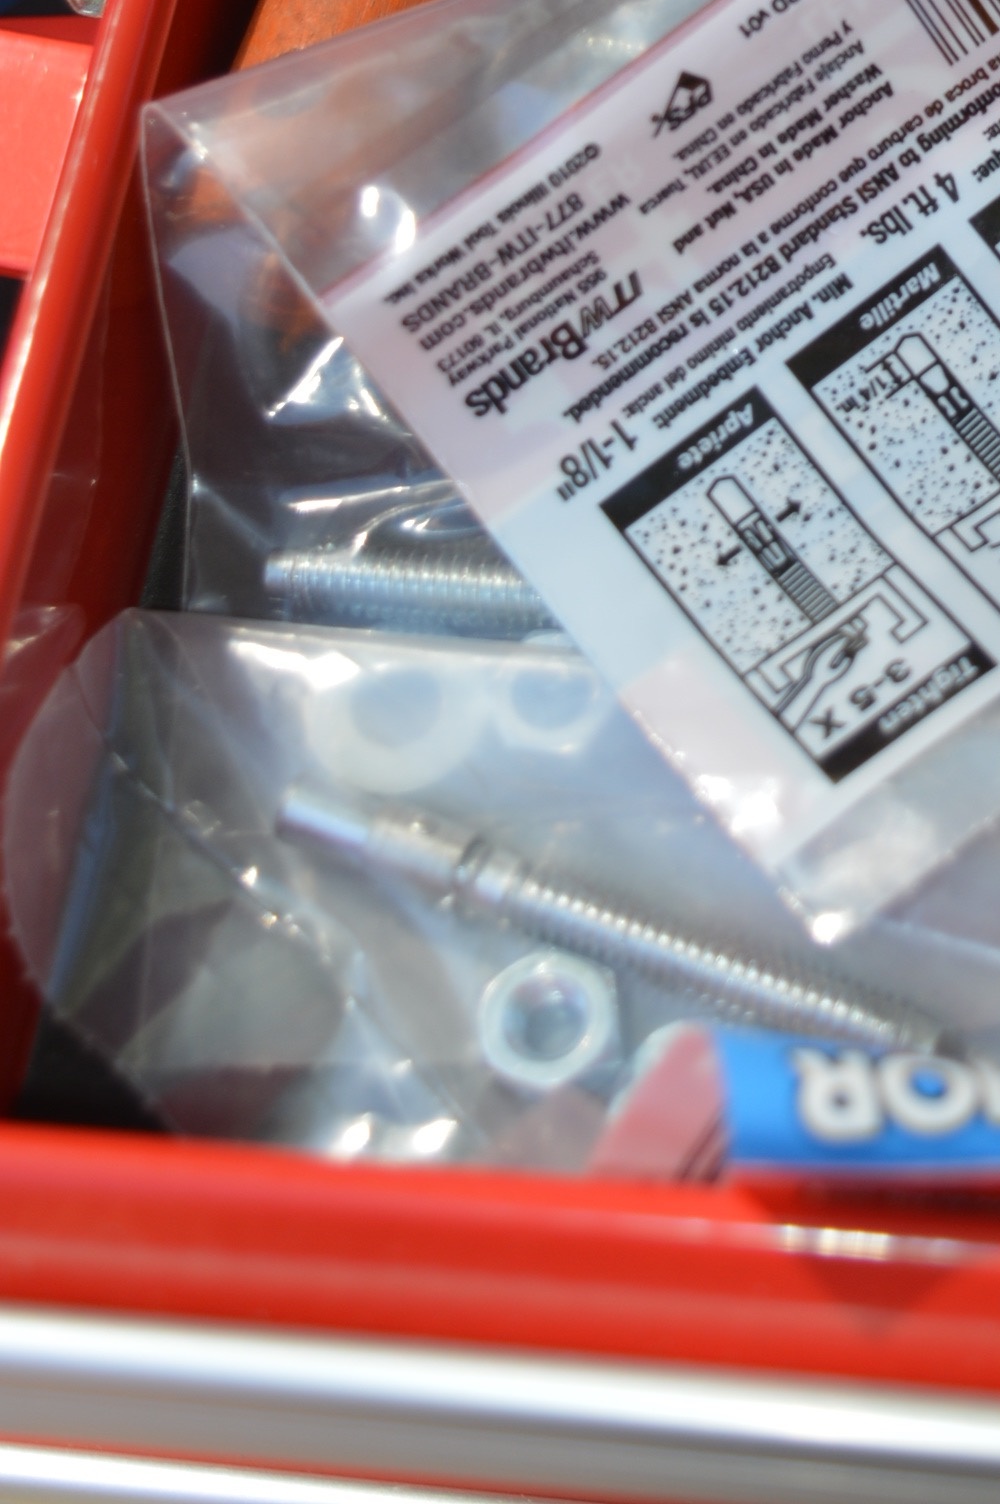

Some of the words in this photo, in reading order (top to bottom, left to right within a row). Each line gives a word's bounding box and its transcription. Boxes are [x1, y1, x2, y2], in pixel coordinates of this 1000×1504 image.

[734, 60, 804, 117] Fabricado
[747, 76, 817, 134] Fabricado
[821, 61, 883, 113] Washer
[836, 79, 895, 130] Anchor
[943, 65, 990, 104] broca
[715, 111, 736, 131] en
[775, 106, 824, 146] Made
[922, 97, 945, 119] de
[727, 127, 749, 148] en
[756, 140, 778, 160] in
[790, 122, 839, 163] Made
[865, 113, 925, 162] carburo
[897, 147, 922, 169] to
[771, 156, 794, 177] in
[836, 155, 868, 184] que
[854, 161, 900, 204] ANSI
[931, 169, 962, 204] 4
[702, 199, 737, 230] Nut
[768, 178, 839, 237] conforme
[900, 183, 940, 220] ft.
[671, 222, 706, 255] and
[756, 230, 770, 245] a
[777, 194, 859, 263] Standard
[858, 204, 914, 249] lbs.
[739, 239, 760, 258] la
[692, 252, 742, 294] norma
[706, 253, 782, 317] B212.15
[733, 251, 836, 333] Empotramiento
[810, 272, 853, 306] Min.
[654, 289, 694, 324] ANSI
[857, 261, 943, 332] Martille
[687, 307, 711, 330] is
[752, 300, 815, 354] Anchor
[561, 321, 691, 425] recommended.
[650, 345, 757, 431] Embedment:
[662, 364, 689, 391] del
[620, 380, 666, 421] ancla:
[674, 400, 757, 471] Apriete
[846, 658, 912, 713] 3-5
[869, 649, 977, 734] Tighten
[809, 708, 844, 739] X
